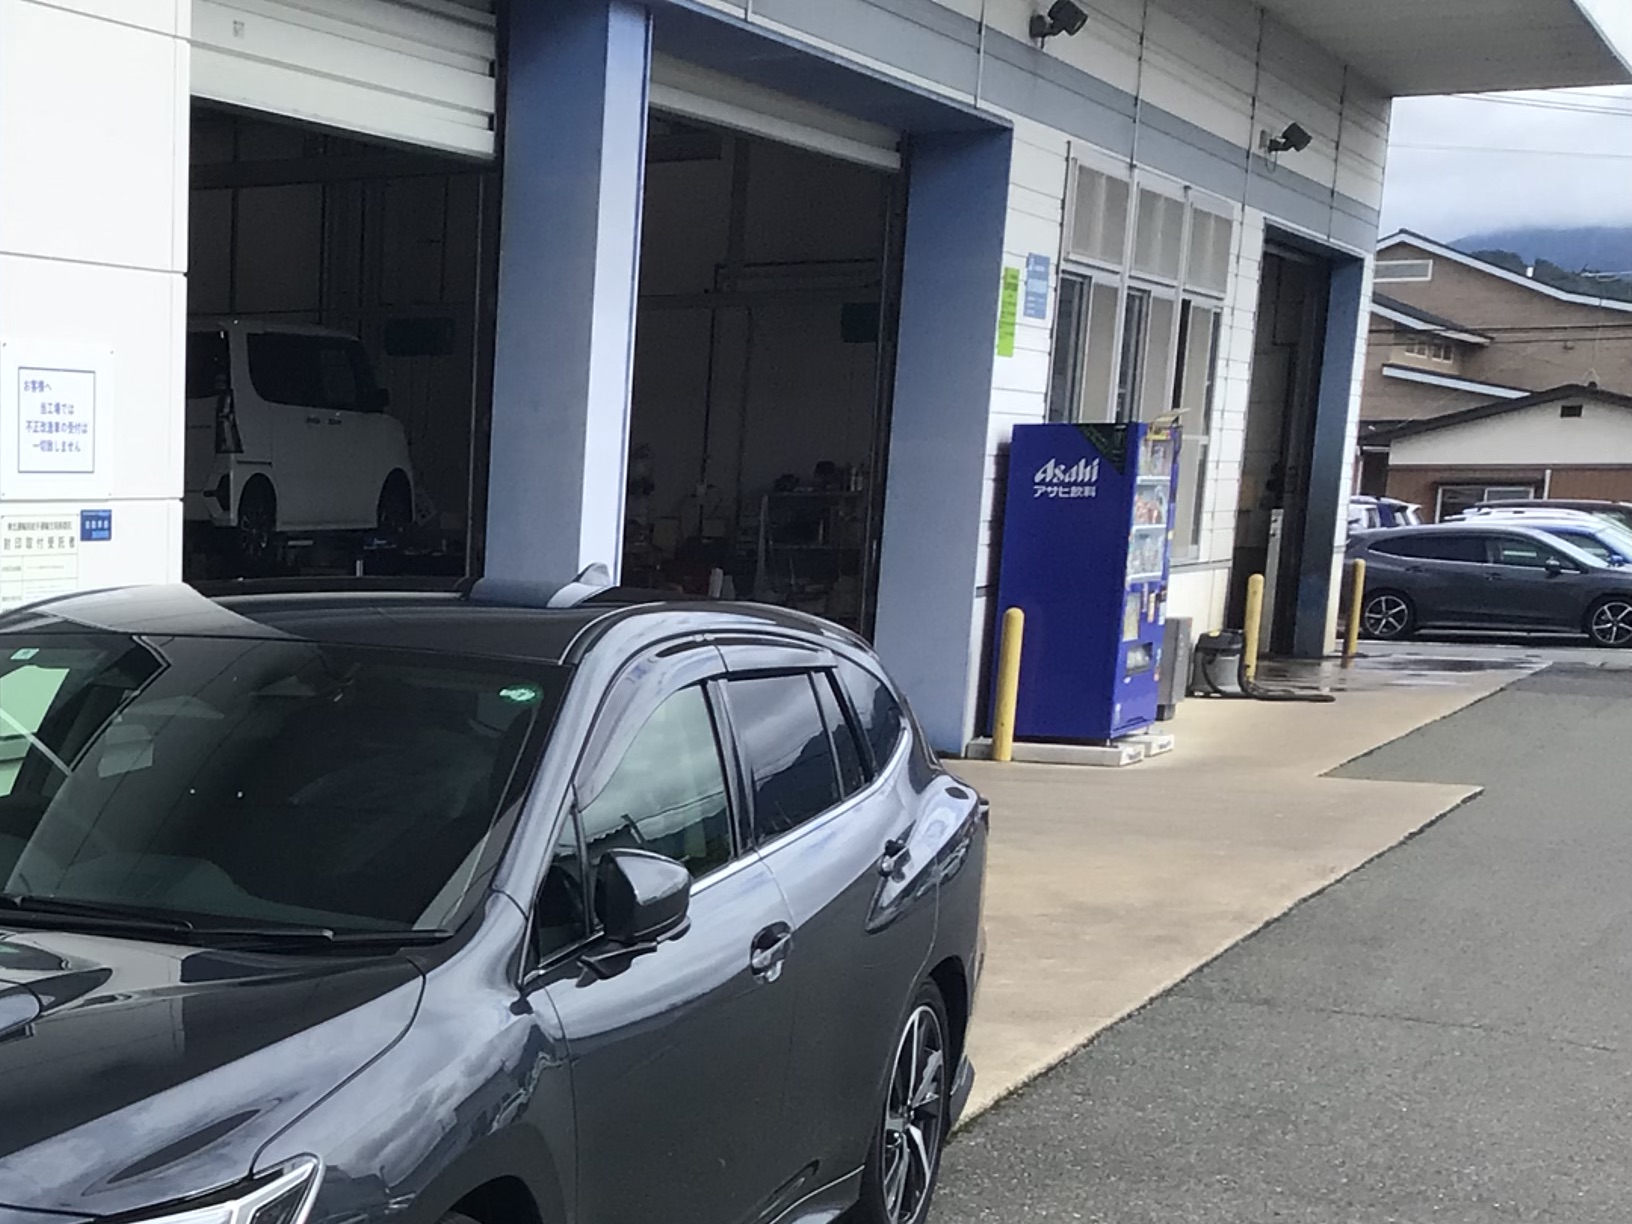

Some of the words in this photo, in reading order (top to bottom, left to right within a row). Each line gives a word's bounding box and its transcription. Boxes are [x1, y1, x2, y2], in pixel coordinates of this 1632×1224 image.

[1034, 457, 1100, 483] Asahi
[1033, 485, 1097, 498] アサヒ飲料
